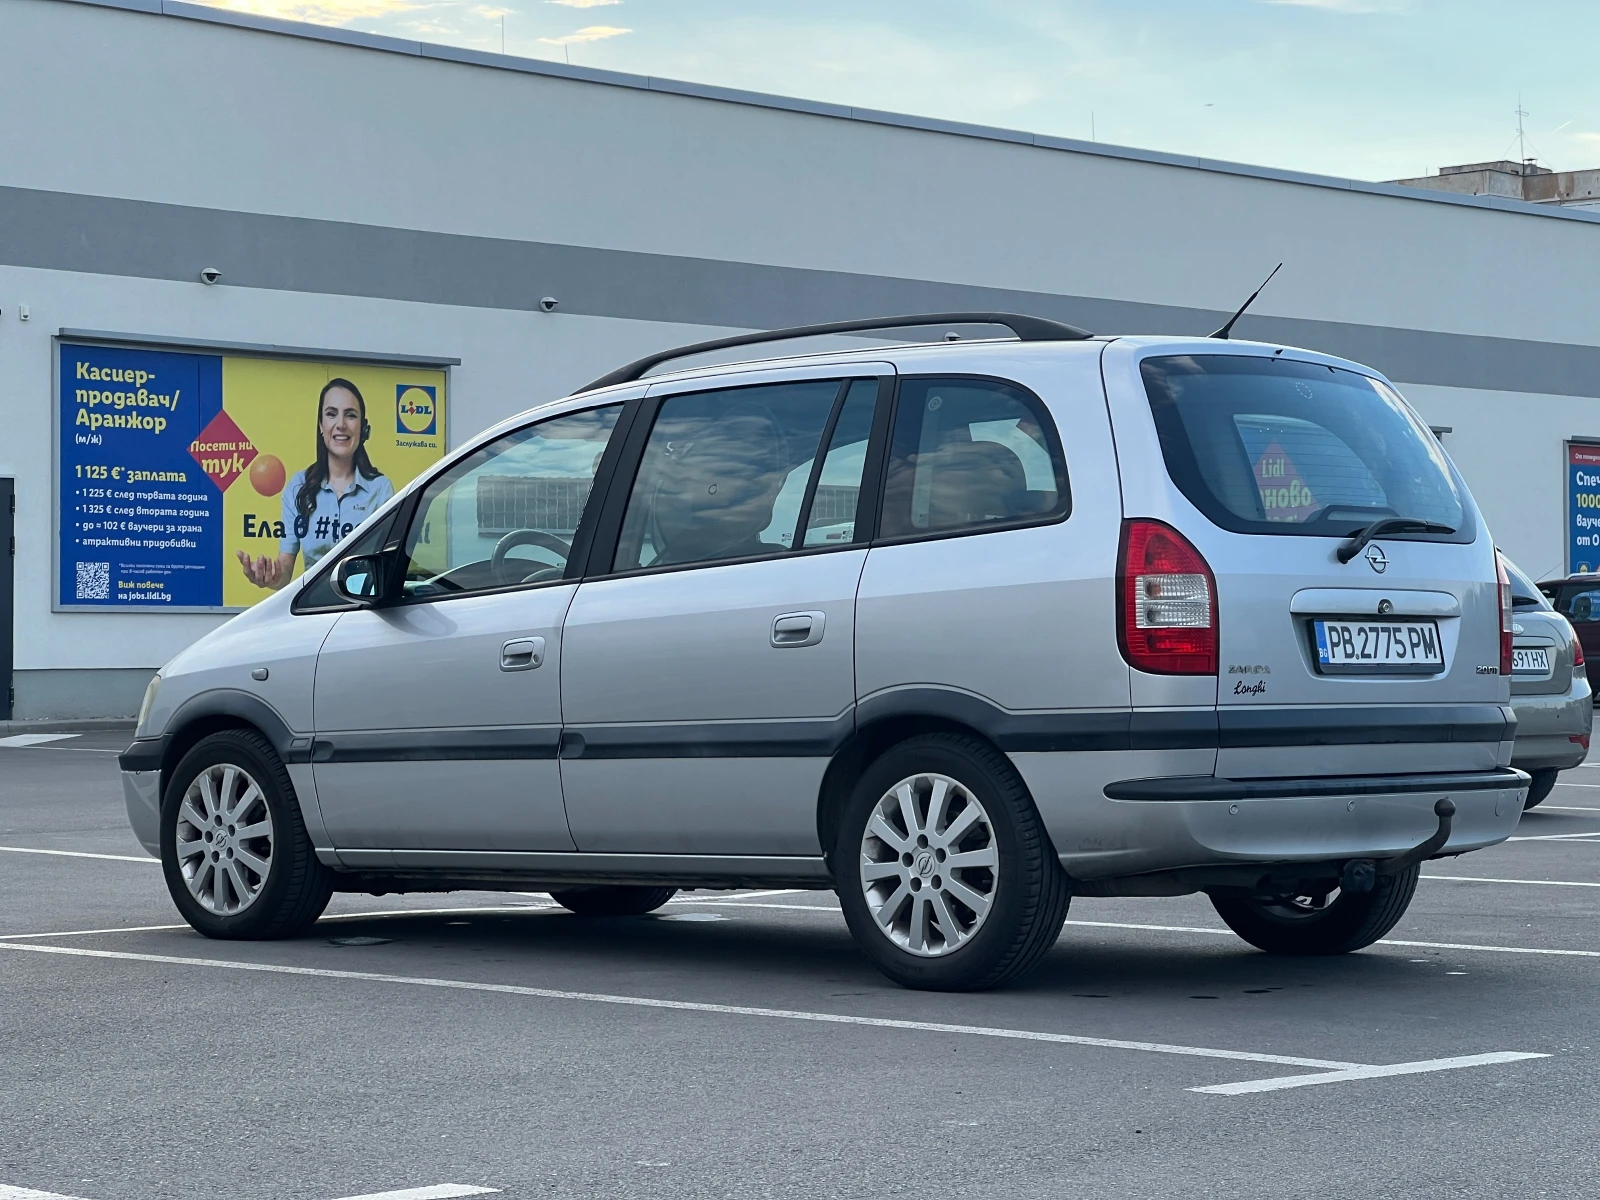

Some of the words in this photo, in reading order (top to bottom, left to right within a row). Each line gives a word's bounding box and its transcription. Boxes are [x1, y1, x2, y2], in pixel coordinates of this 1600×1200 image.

[76, 361, 156, 387] Касиер-
[75, 389, 181, 412] продавач/
[75, 408, 167, 434] Аранжор
[75, 433, 102, 445] (м/ж)
[190, 440, 236, 452] Посети
[238, 441, 253, 450] ни
[395, 439, 428, 448] Заслужава
[201, 452, 245, 478] тук
[1262, 458, 1285, 478] Lidl
[126, 470, 187, 484] заплата
[106, 489, 112, 498] €
[114, 492, 135, 501] след
[136, 490, 176, 501] първата
[177, 494, 208, 503] година
[106, 505, 112, 514] €
[114, 507, 135, 517] след
[136, 506, 178, 517] втората
[179, 509, 210, 519] година
[82, 522, 94, 531] до
[103, 521, 118, 530] 102
[120, 521, 126, 530] €
[127, 521, 164, 533] ваучери
[165, 524, 176, 534] за
[177, 525, 203, 534] храна
[243, 514, 287, 538] Ела
[293, 514, 309, 539] в
[82, 537, 141, 548] атрактивни
[143, 538, 197, 549] придобивки
[1576, 536, 1591, 546] от
[118, 580, 135, 589] Виж
[136, 580, 164, 589] повече
[128, 591, 172, 602] jobs.lidl.bg
[1318, 647, 1328, 658] BG
[1233, 679, 1266, 697] Longhi
